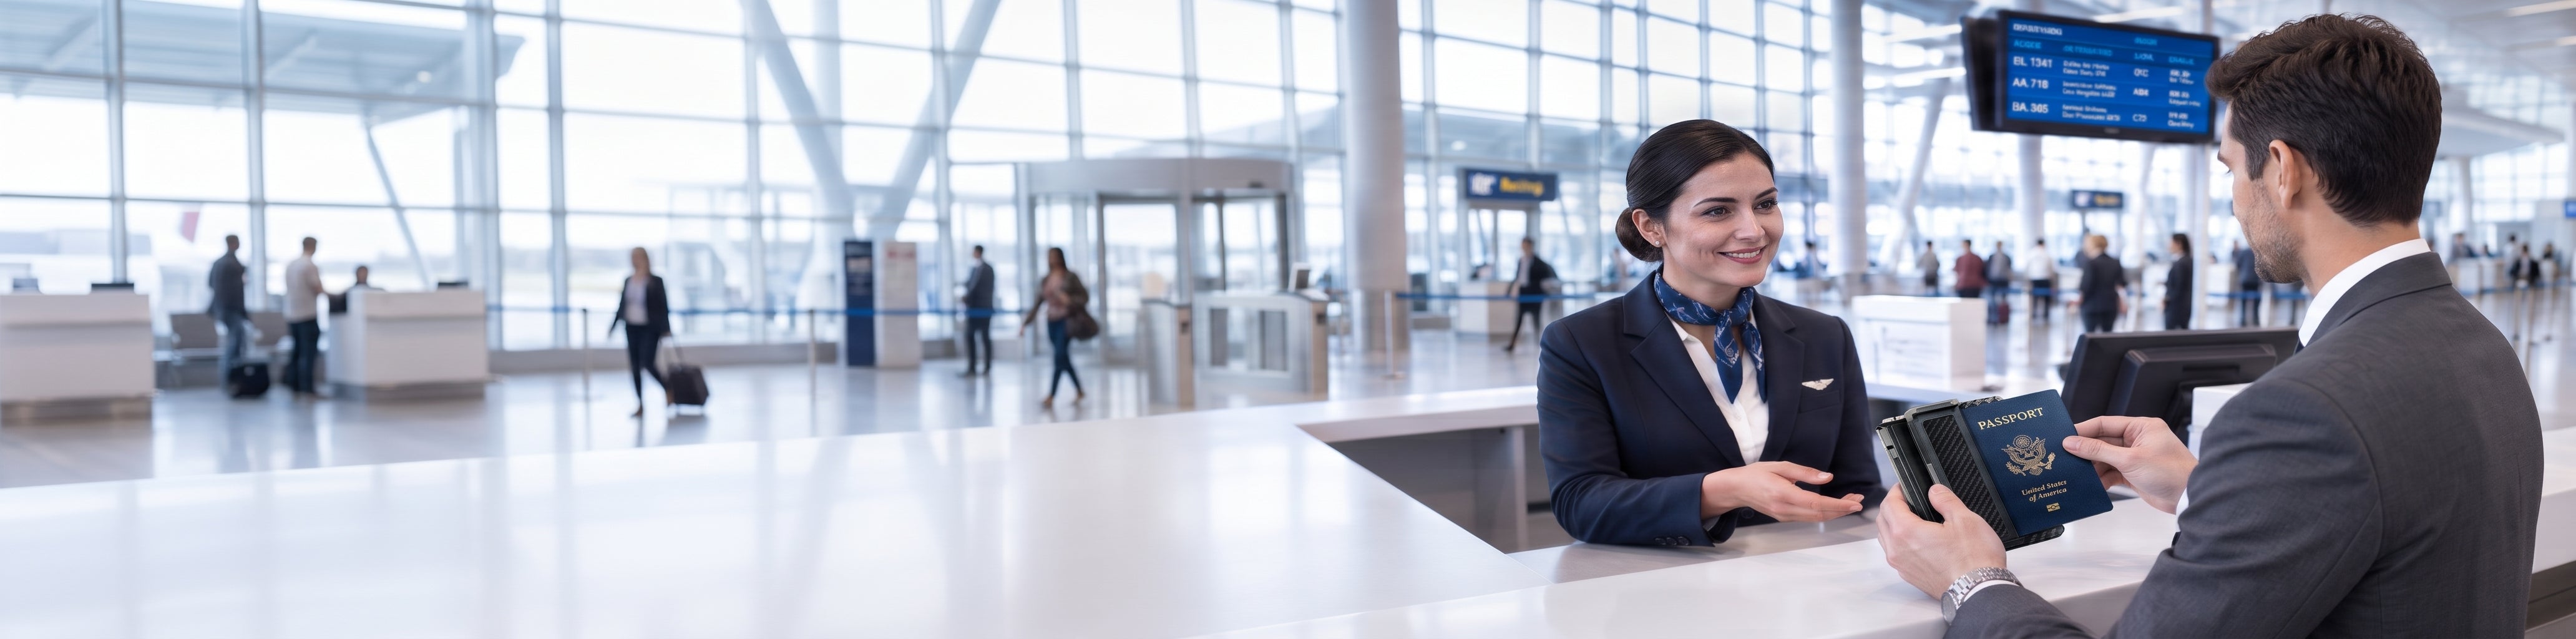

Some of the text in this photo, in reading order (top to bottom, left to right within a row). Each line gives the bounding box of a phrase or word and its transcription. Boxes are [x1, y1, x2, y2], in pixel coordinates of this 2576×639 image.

[1978, 407, 2043, 430] PASSPORT
[2029, 488, 2067, 502] of America
